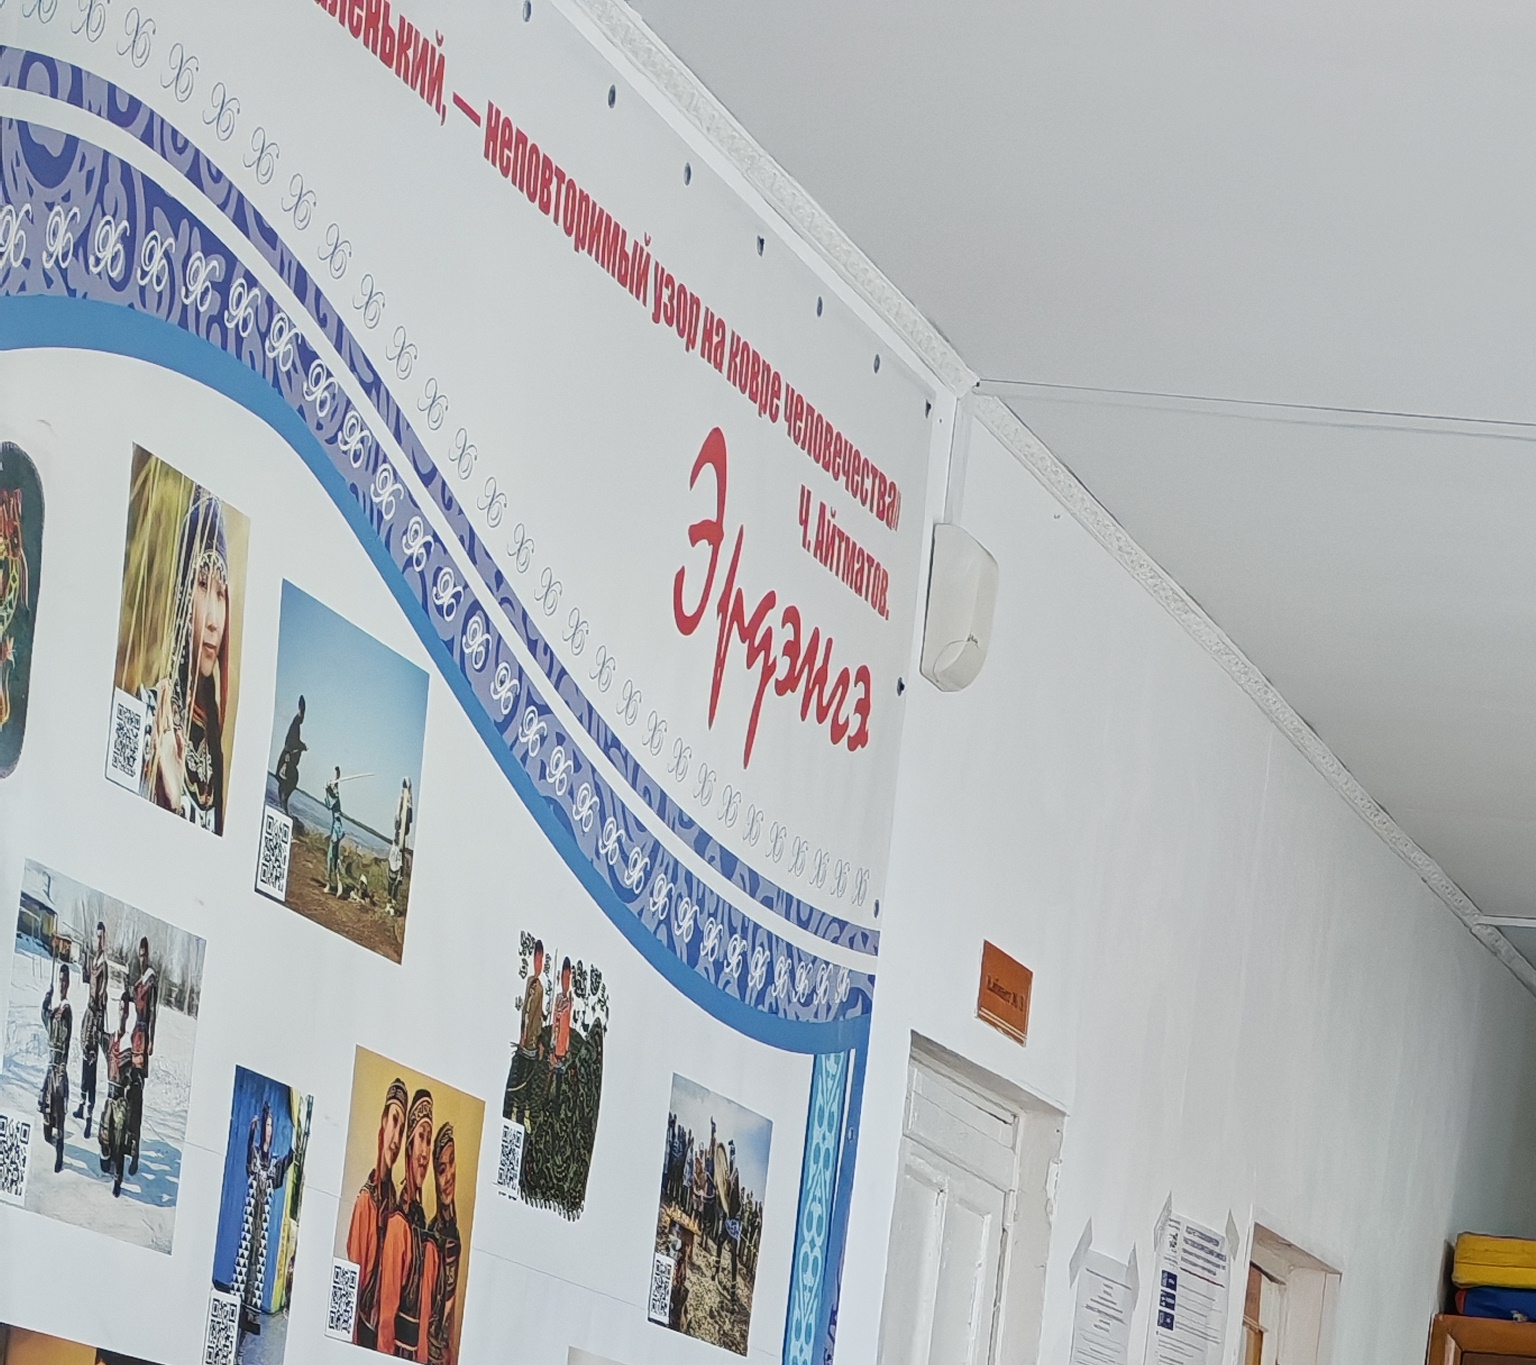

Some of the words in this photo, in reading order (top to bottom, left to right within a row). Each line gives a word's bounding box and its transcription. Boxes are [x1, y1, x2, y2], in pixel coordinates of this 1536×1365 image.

[313, 0, 446, 126] ленький,
[484, 100, 652, 308] неповторимый
[651, 260, 702, 353] узор
[700, 305, 726, 374] на
[726, 328, 782, 423] ковре
[813, 500, 891, 621] Айтматов.
